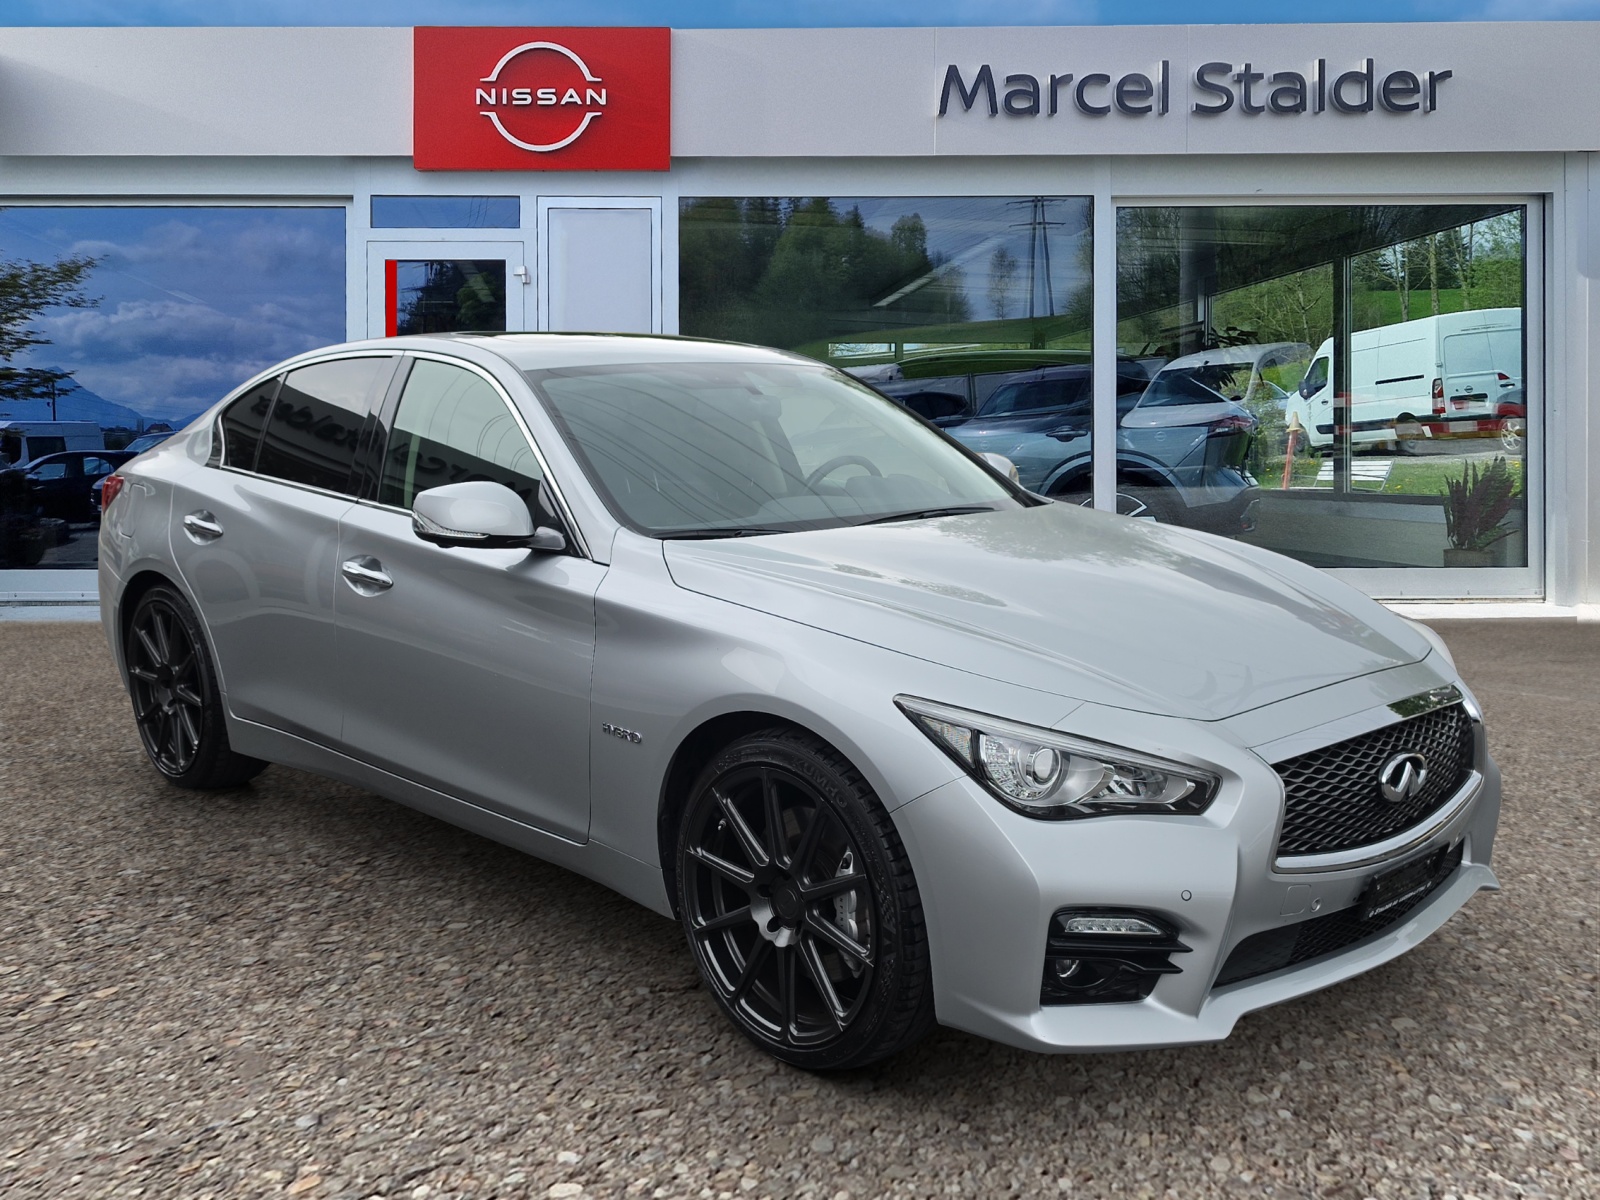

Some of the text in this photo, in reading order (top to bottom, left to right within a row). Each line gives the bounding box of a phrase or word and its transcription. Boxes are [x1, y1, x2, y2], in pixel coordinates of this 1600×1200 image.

[475, 88, 607, 105] NISSAN
[937, 58, 1453, 118] Marcel Stalder
[794, 757, 848, 808] KUMHO
